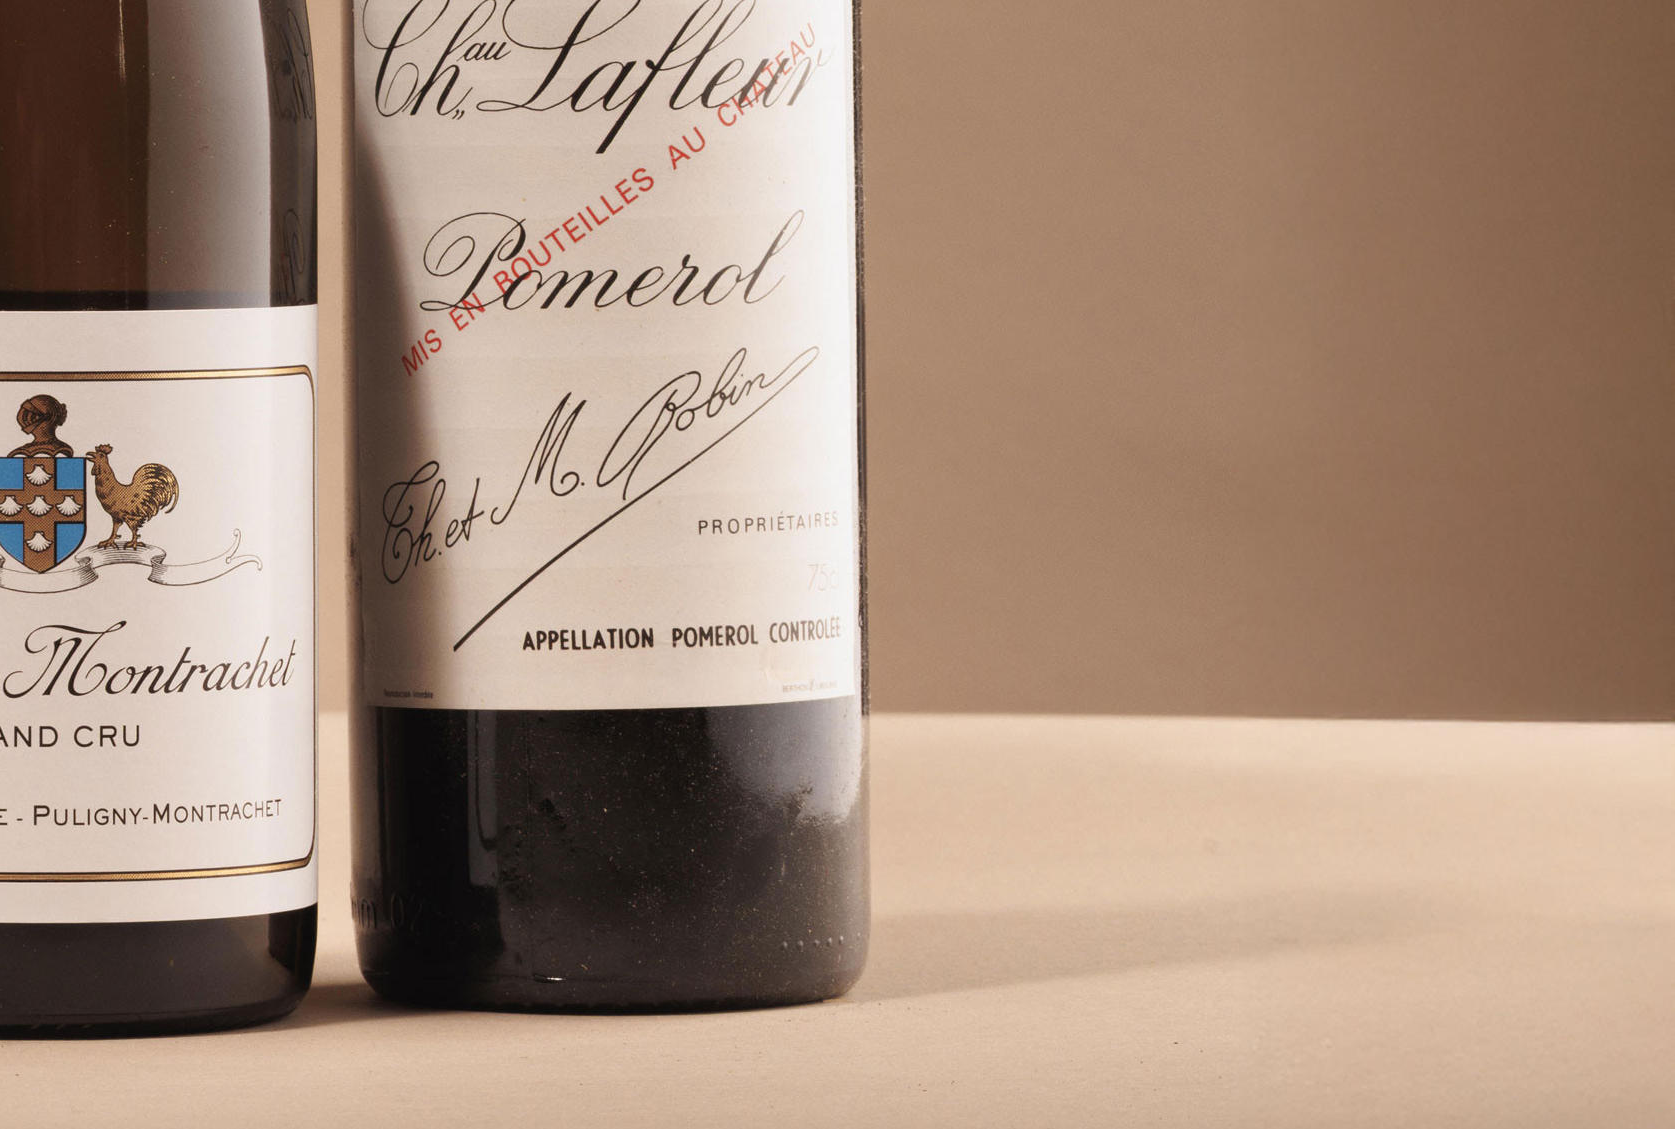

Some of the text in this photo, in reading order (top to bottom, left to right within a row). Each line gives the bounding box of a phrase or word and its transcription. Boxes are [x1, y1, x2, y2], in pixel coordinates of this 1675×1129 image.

[401, 23, 816, 376] MIS EN BOUTEILLES AU CHATEAU
[420, 209, 804, 311] Pomerol
[698, 510, 839, 535] PROPRIÉTAIRES
[523, 627, 654, 651] APPELLATION
[672, 624, 759, 648] POMEROL
[73, 724, 140, 748] CRU
